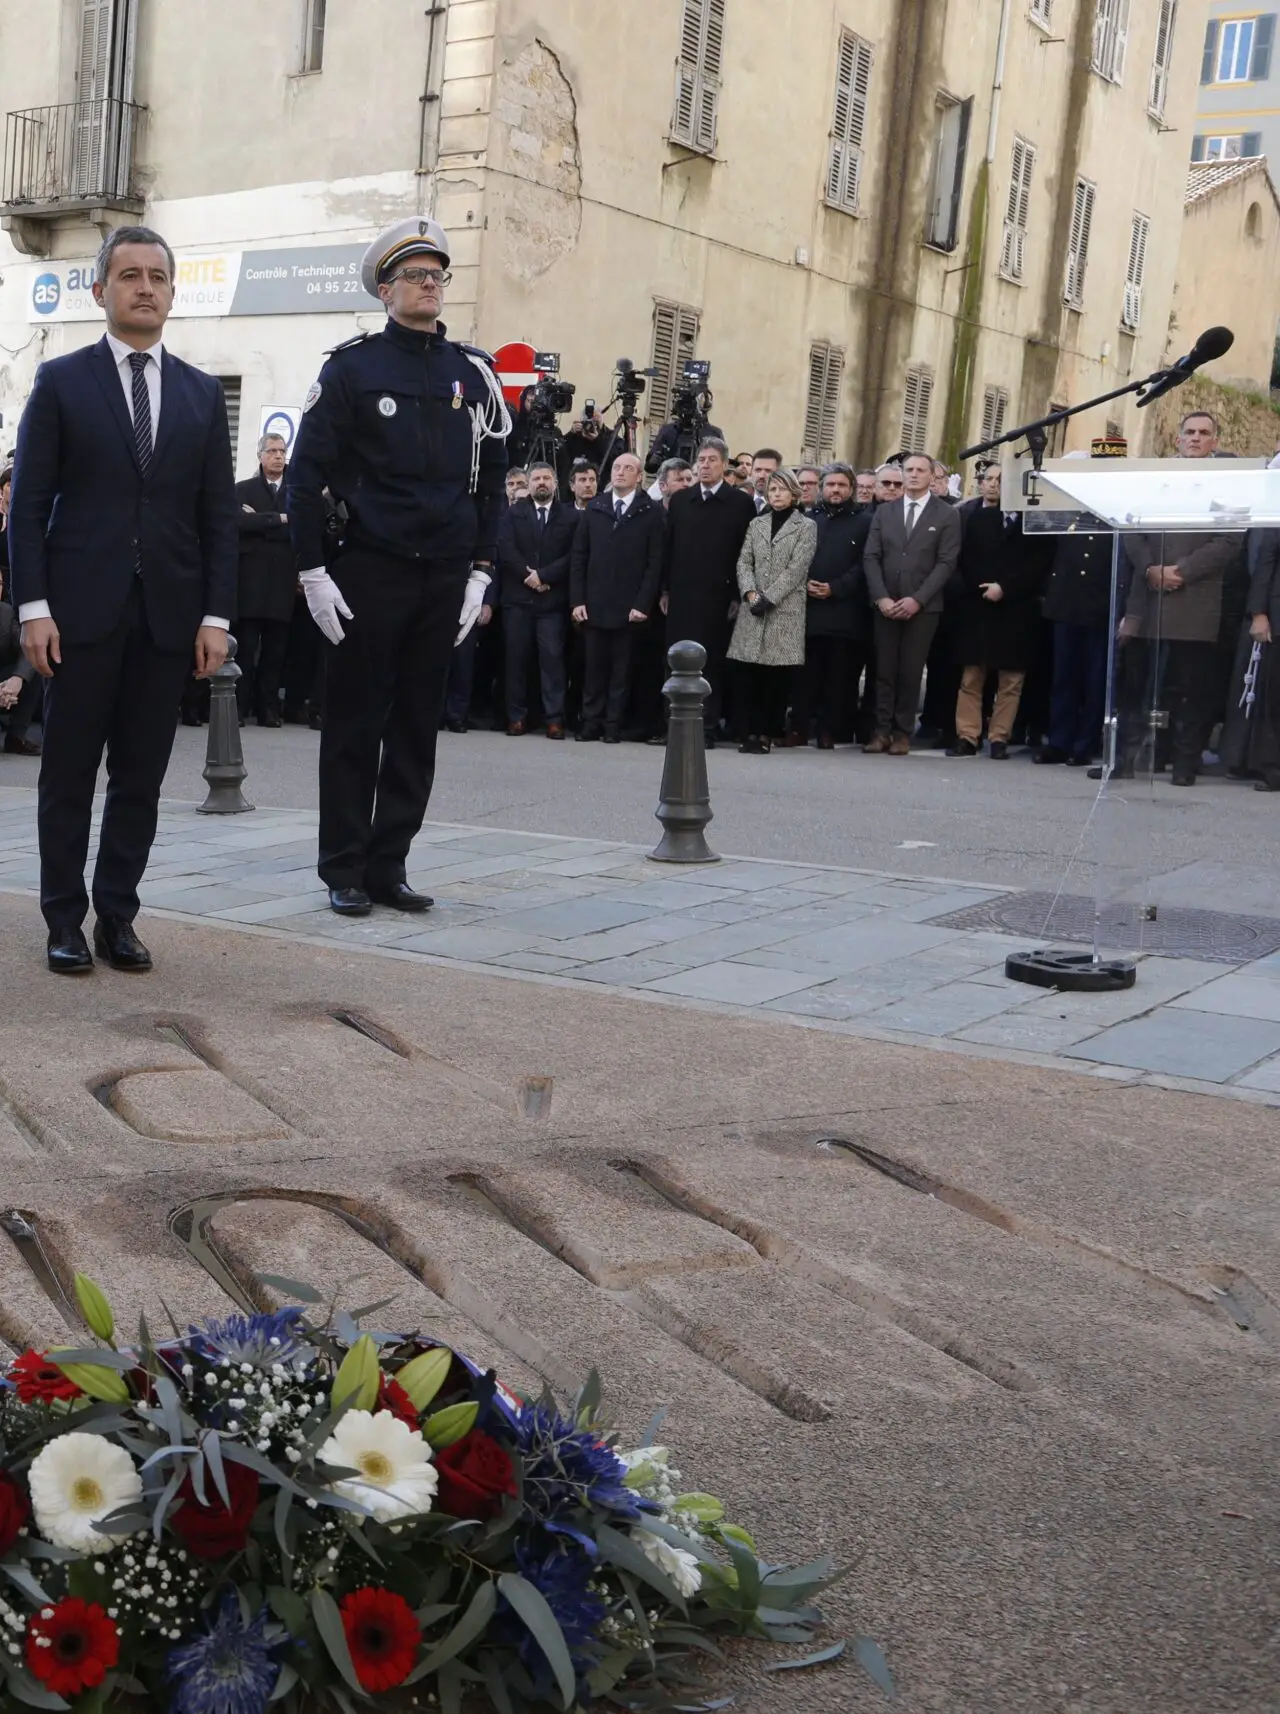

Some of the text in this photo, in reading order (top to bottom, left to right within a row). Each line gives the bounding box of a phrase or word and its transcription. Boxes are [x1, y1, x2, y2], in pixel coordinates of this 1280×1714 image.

[67, 258, 226, 291] au RITÉ
[246, 268, 287, 280] Contrôle
[291, 264, 345, 278] Technique
[34, 284, 58, 304] as
[306, 282, 321, 294] 04
[325, 281, 339, 293] 95
[343, 280, 358, 293] 22
[176, 290, 225, 304] NIQUE
